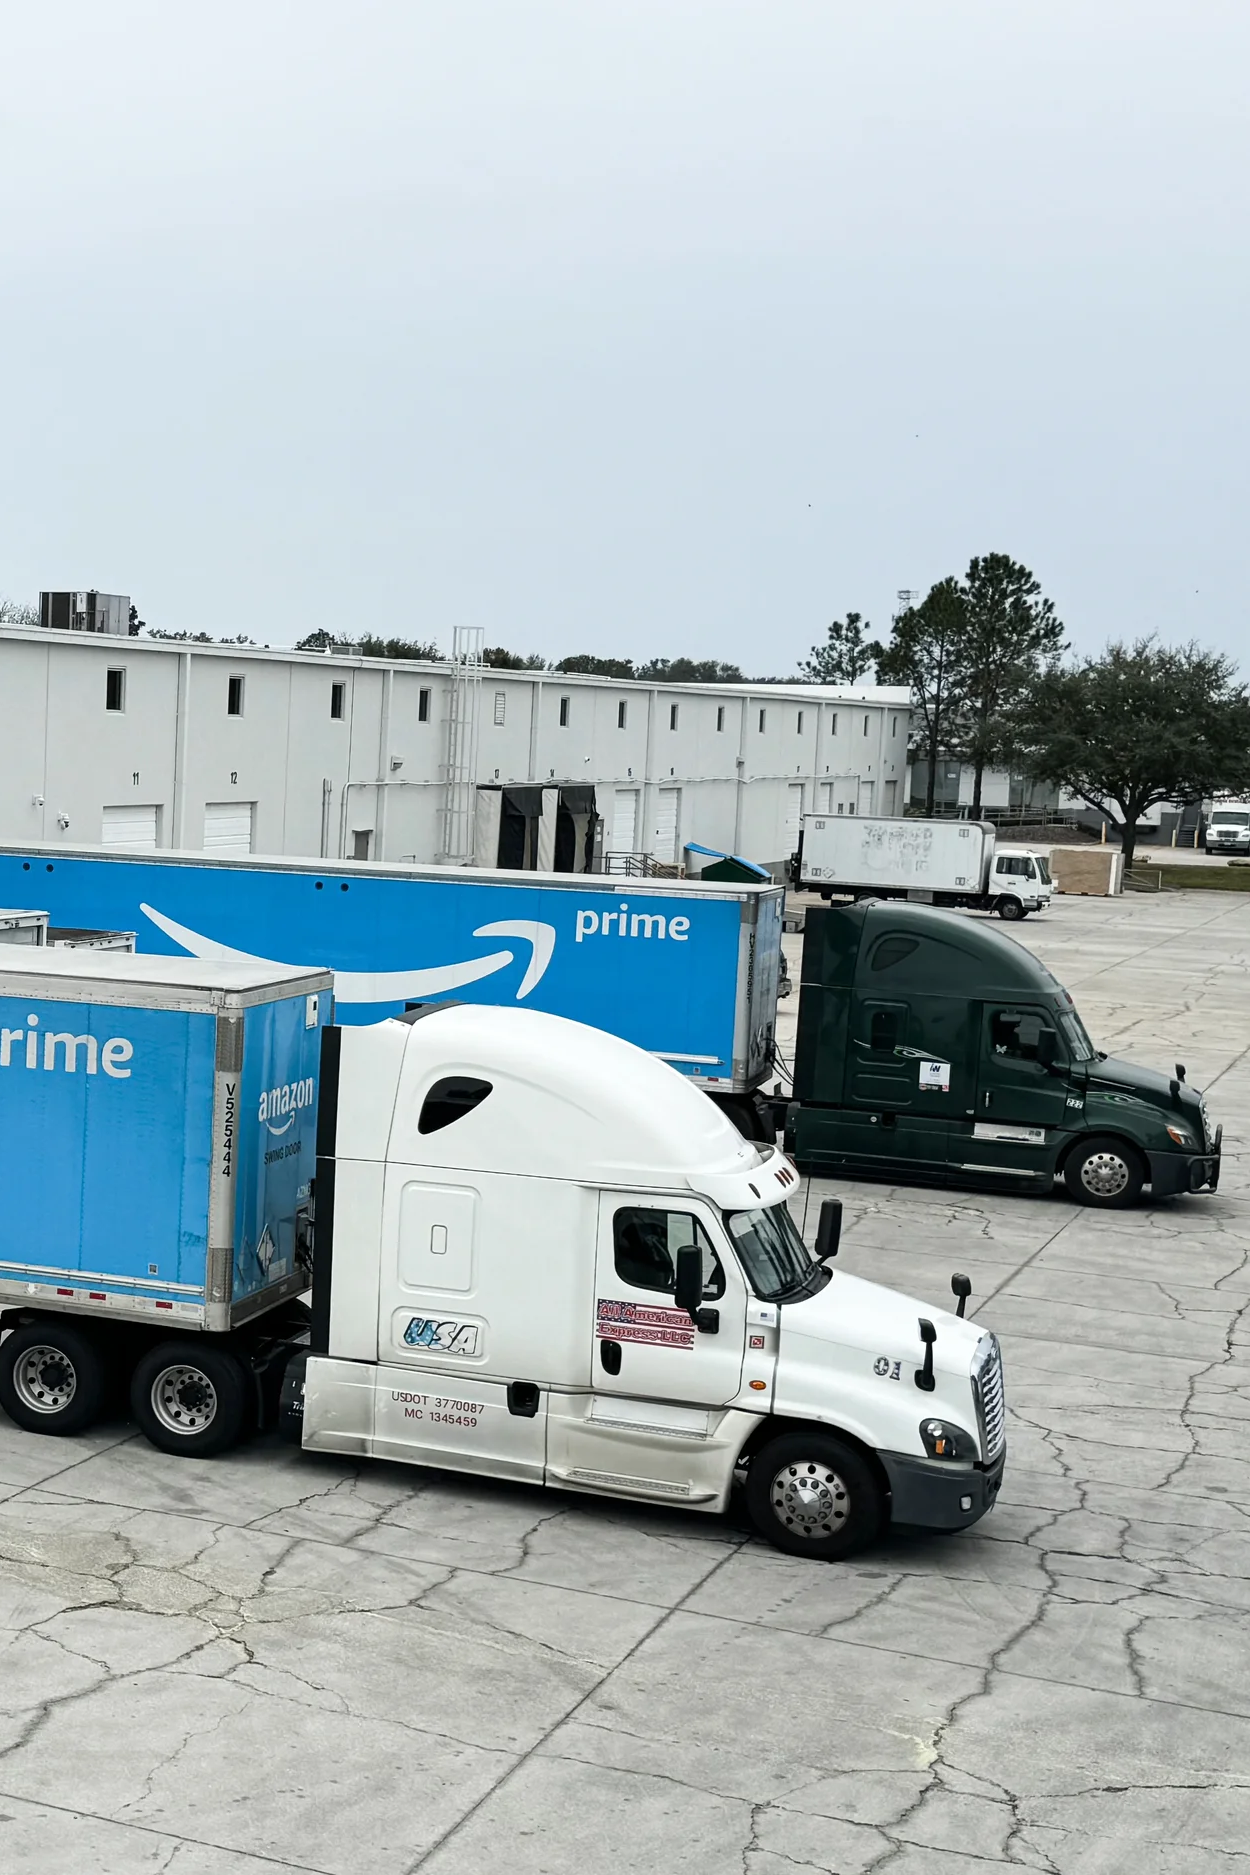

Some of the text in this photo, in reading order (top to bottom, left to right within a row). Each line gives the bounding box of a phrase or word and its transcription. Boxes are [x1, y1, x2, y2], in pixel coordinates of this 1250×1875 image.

[133, 772, 140, 786] 11
[230, 771, 238, 784] 12
[575, 903, 691, 943] prime
[258, 1077, 314, 1122] amazon
[1066, 1098, 1084, 1109] 222
[222, 1083, 236, 1178] V525444
[263, 1140, 302, 1166] SWING DOOR
[599, 1303, 694, 1327] All American
[403, 1317, 479, 1355] USA
[598, 1321, 692, 1345] Express LLC
[873, 1356, 902, 1381] 01
[391, 1391, 485, 1414] USDOT 3770087
[404, 1407, 478, 1427] MC 1345459
